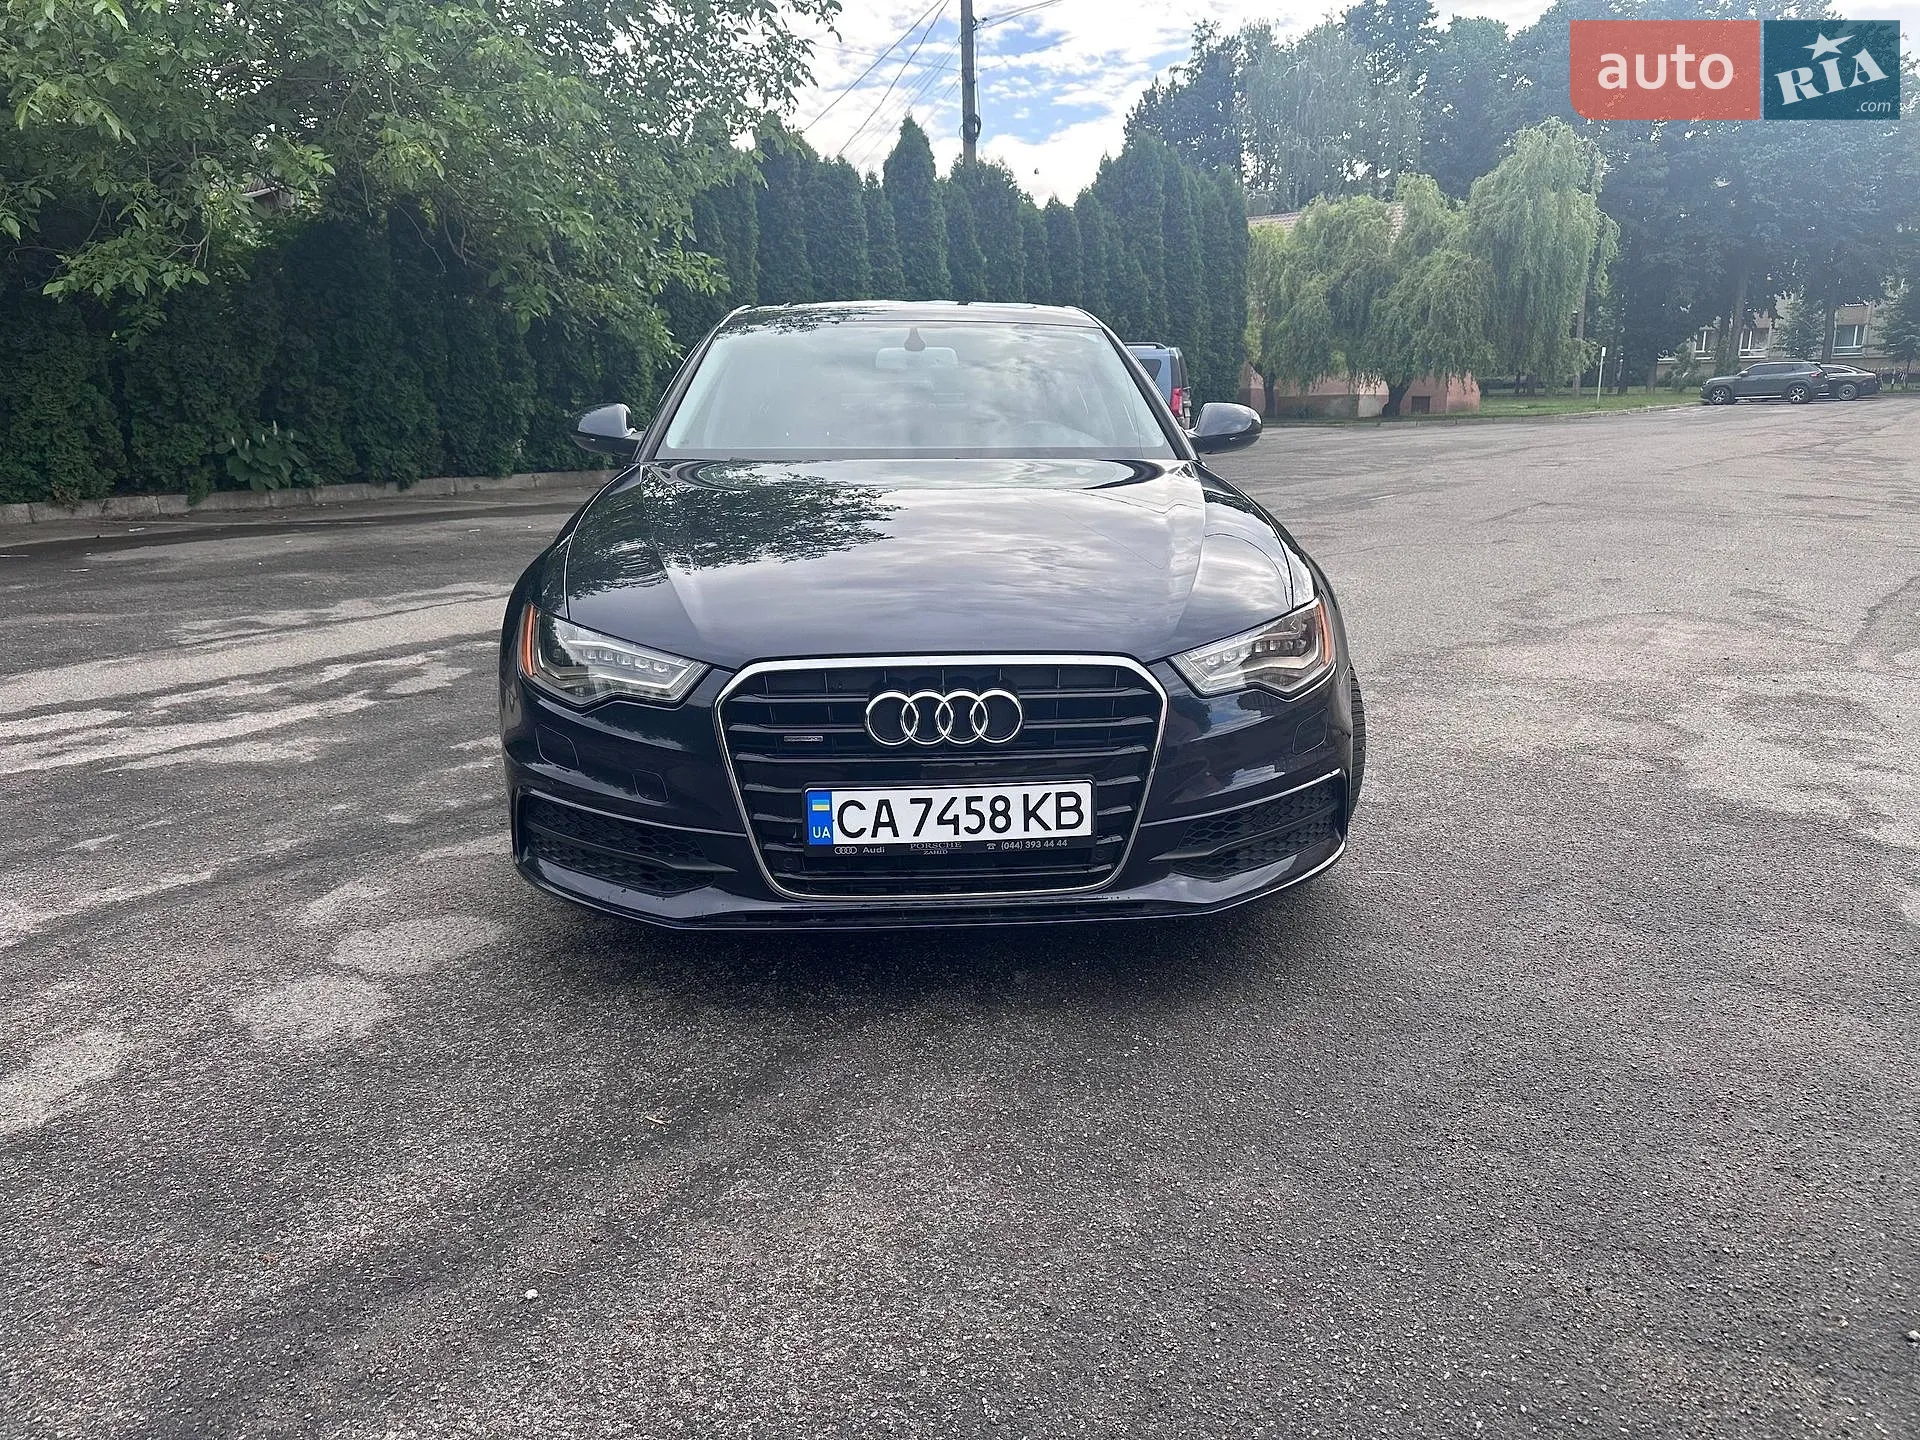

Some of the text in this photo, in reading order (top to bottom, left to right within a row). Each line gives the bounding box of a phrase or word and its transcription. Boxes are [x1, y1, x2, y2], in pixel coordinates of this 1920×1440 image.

[836, 791, 1085, 839] CA 7458 KB
[812, 826, 831, 839] UA
[862, 846, 885, 854] Audi
[909, 842, 962, 850] PORSCHE
[1000, 838, 1068, 851] (044) 393 44 44
